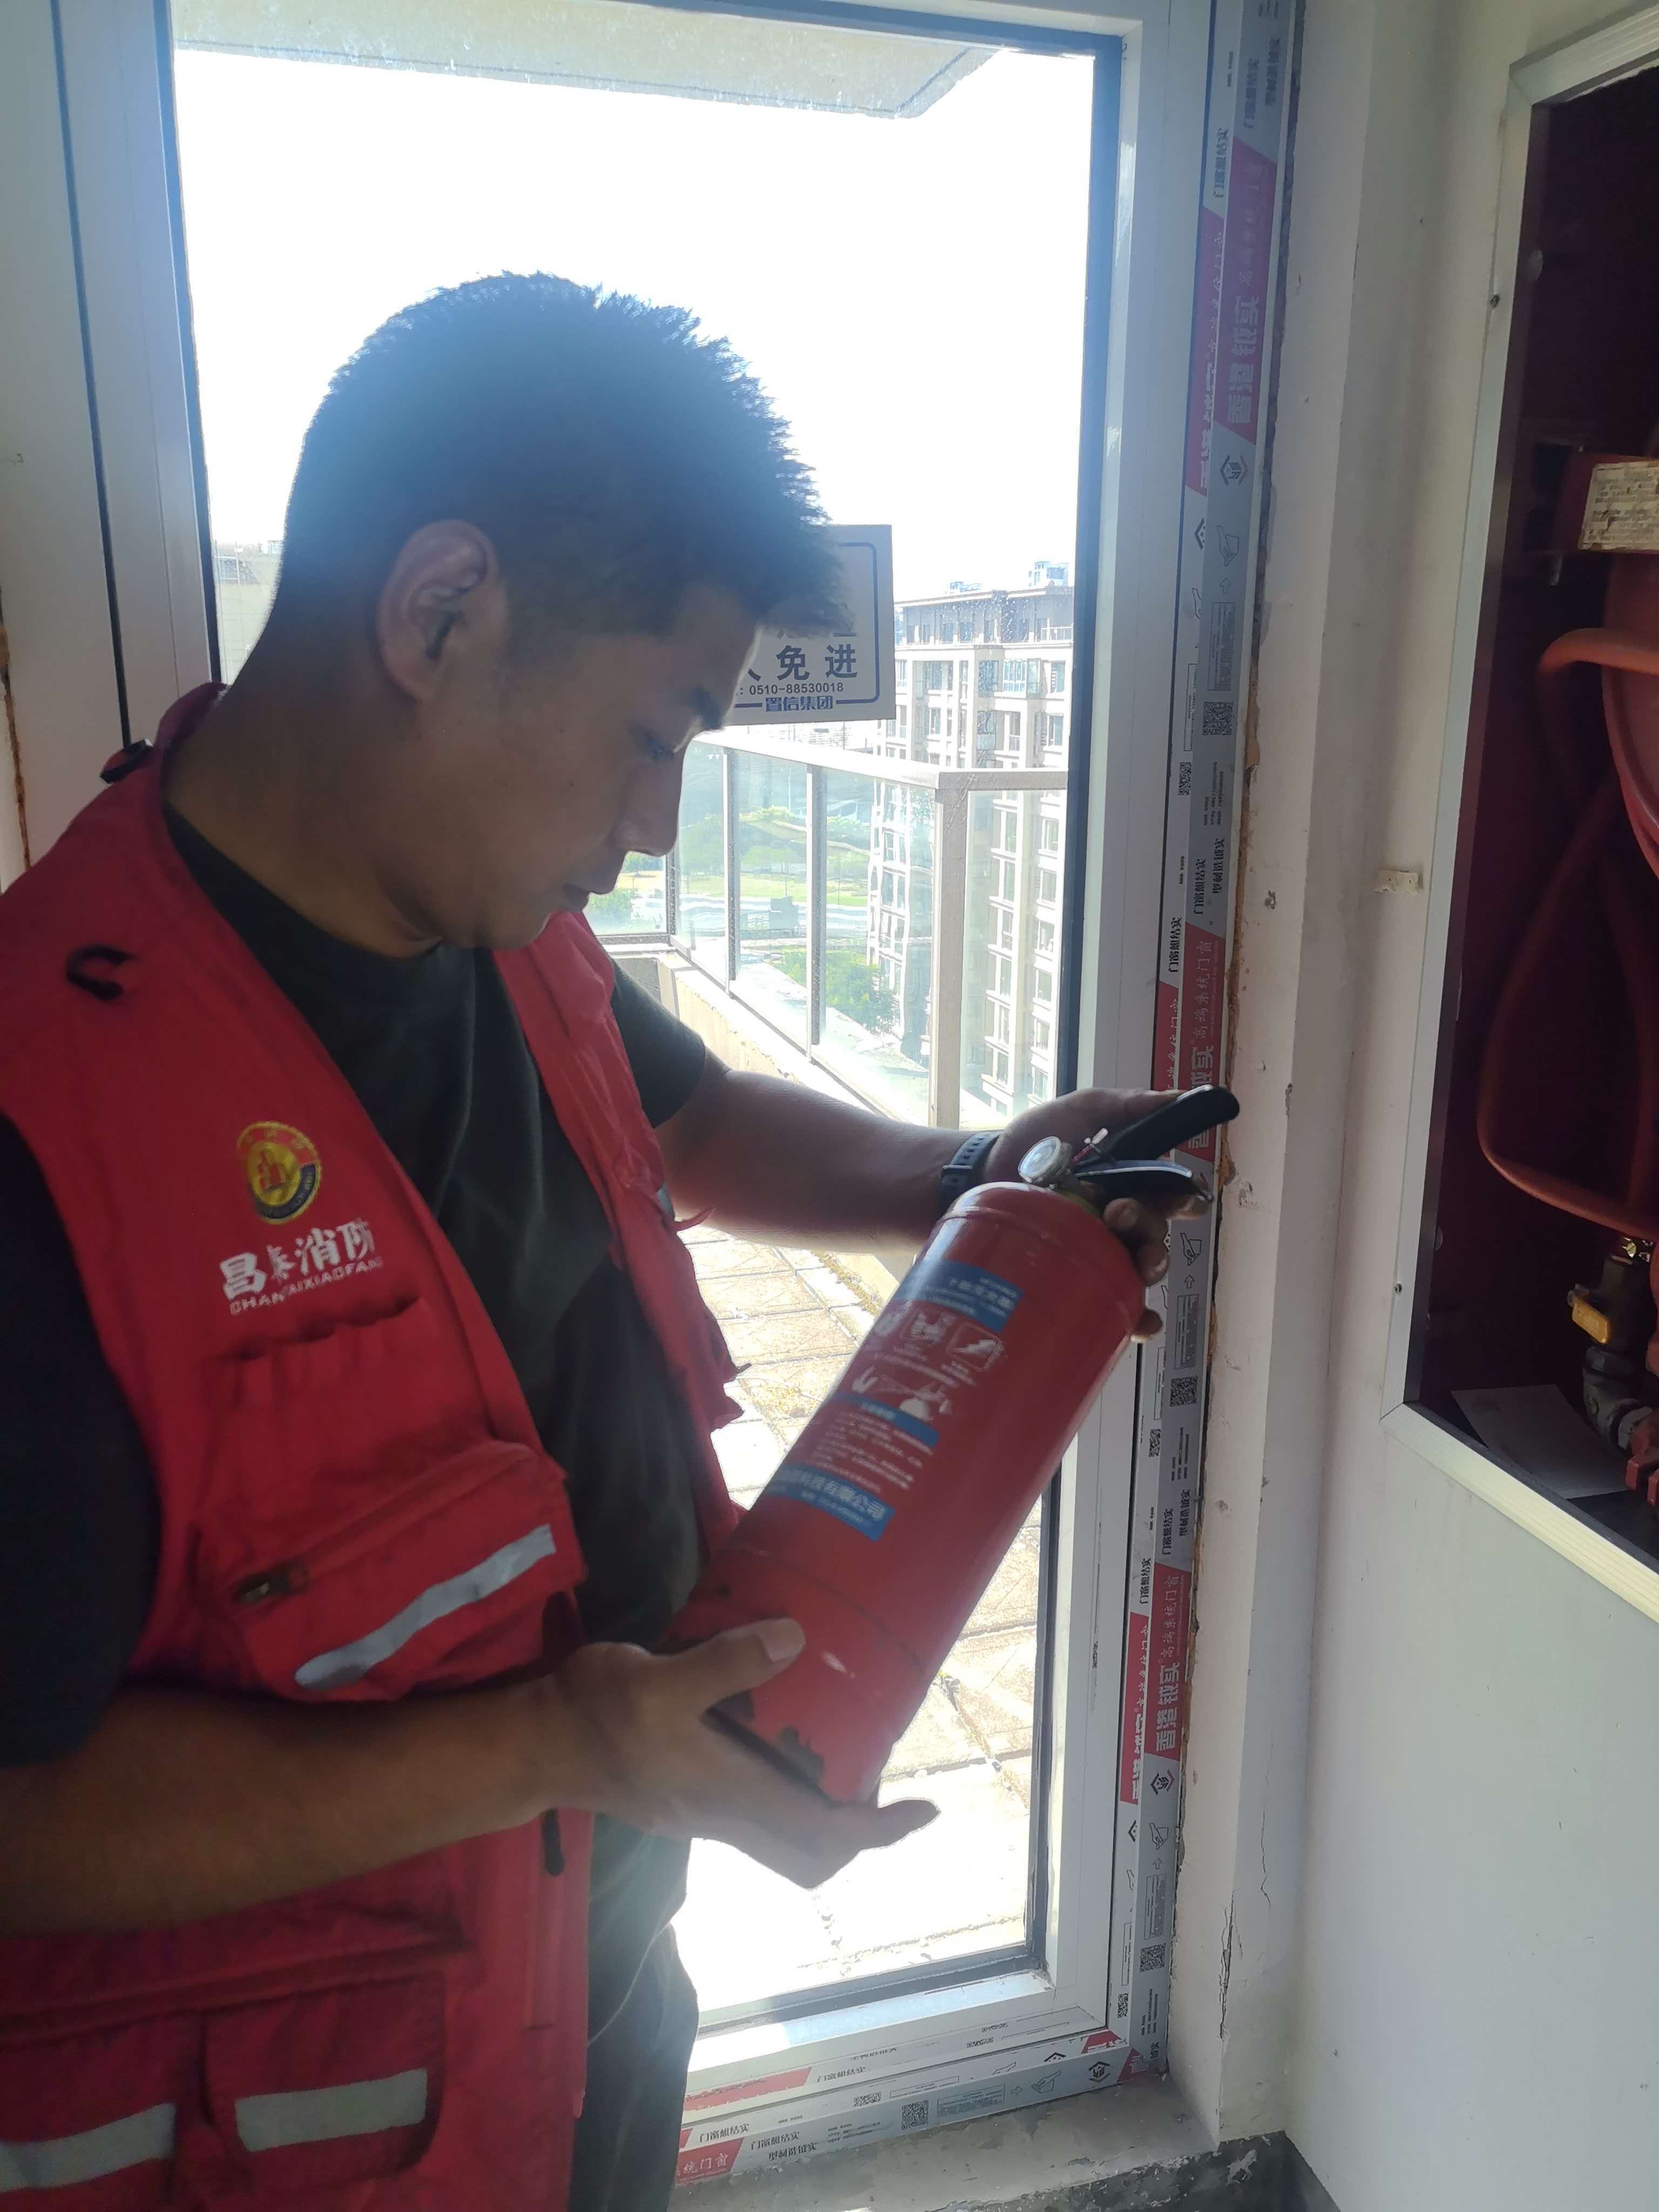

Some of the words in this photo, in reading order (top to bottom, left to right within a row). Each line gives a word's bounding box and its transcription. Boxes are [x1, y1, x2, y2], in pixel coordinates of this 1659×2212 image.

[748, 644, 857, 682] 免进
[749, 682, 844, 696] 0510-88530018
[765, 695, 833, 712] 置信集团
[678, 2152, 729, 2176] 统门窗
